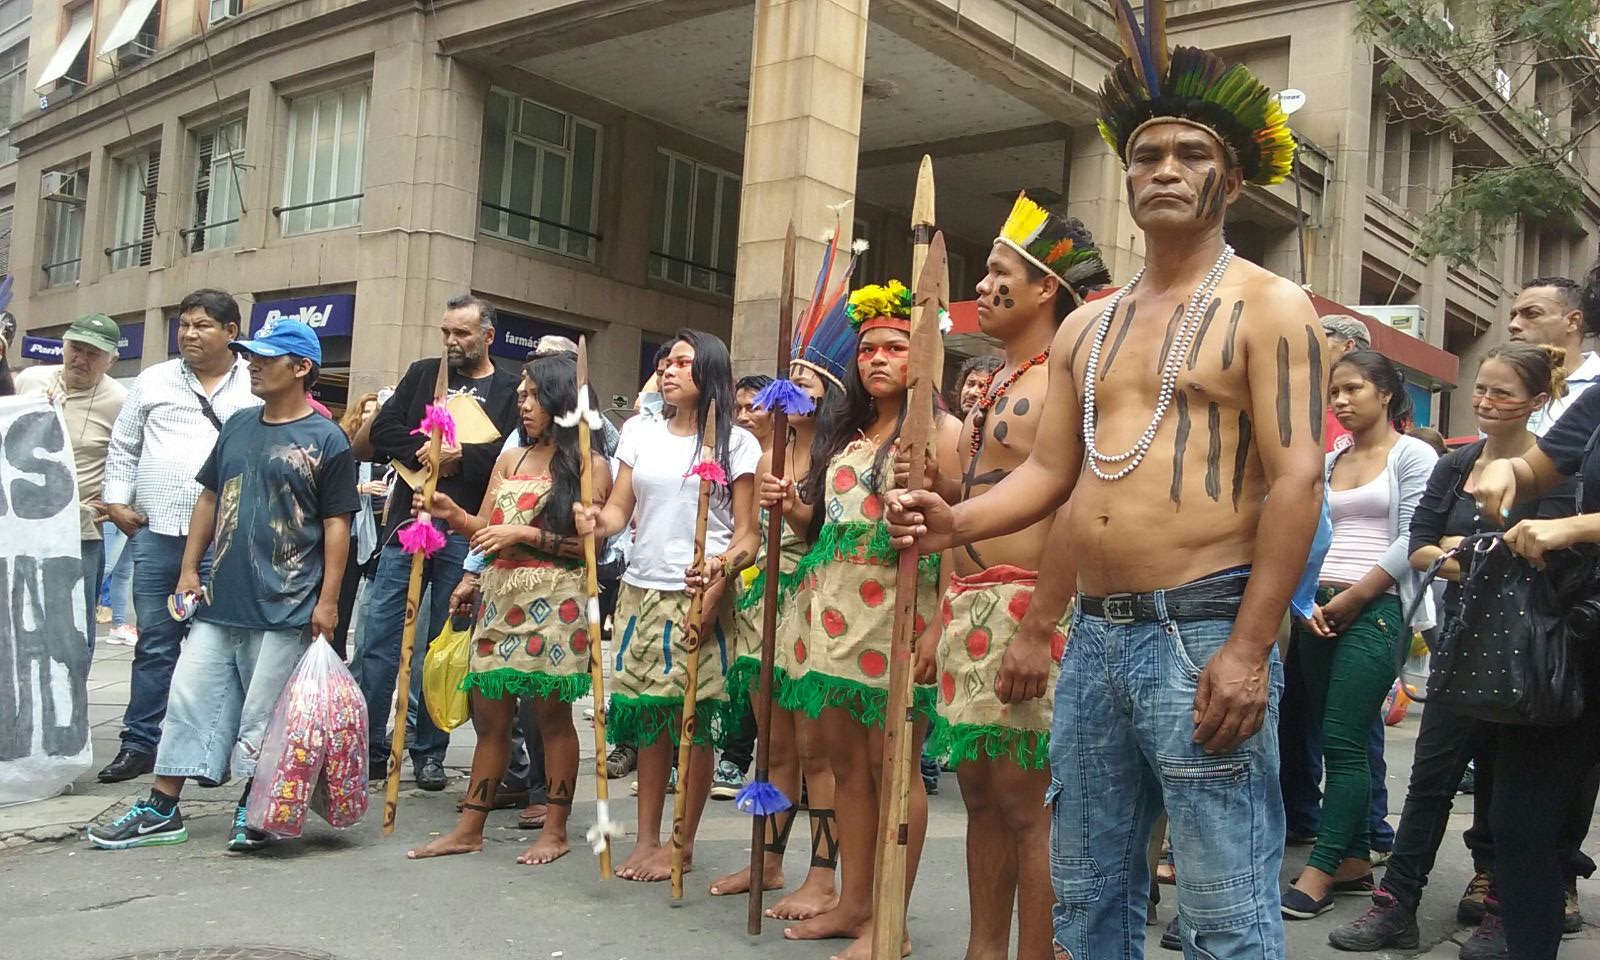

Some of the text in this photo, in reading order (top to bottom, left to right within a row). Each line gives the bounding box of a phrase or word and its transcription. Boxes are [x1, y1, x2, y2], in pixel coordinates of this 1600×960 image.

[505, 331, 541, 348] farmác
[29, 343, 64, 356] PanV
[0, 411, 74, 519] S
